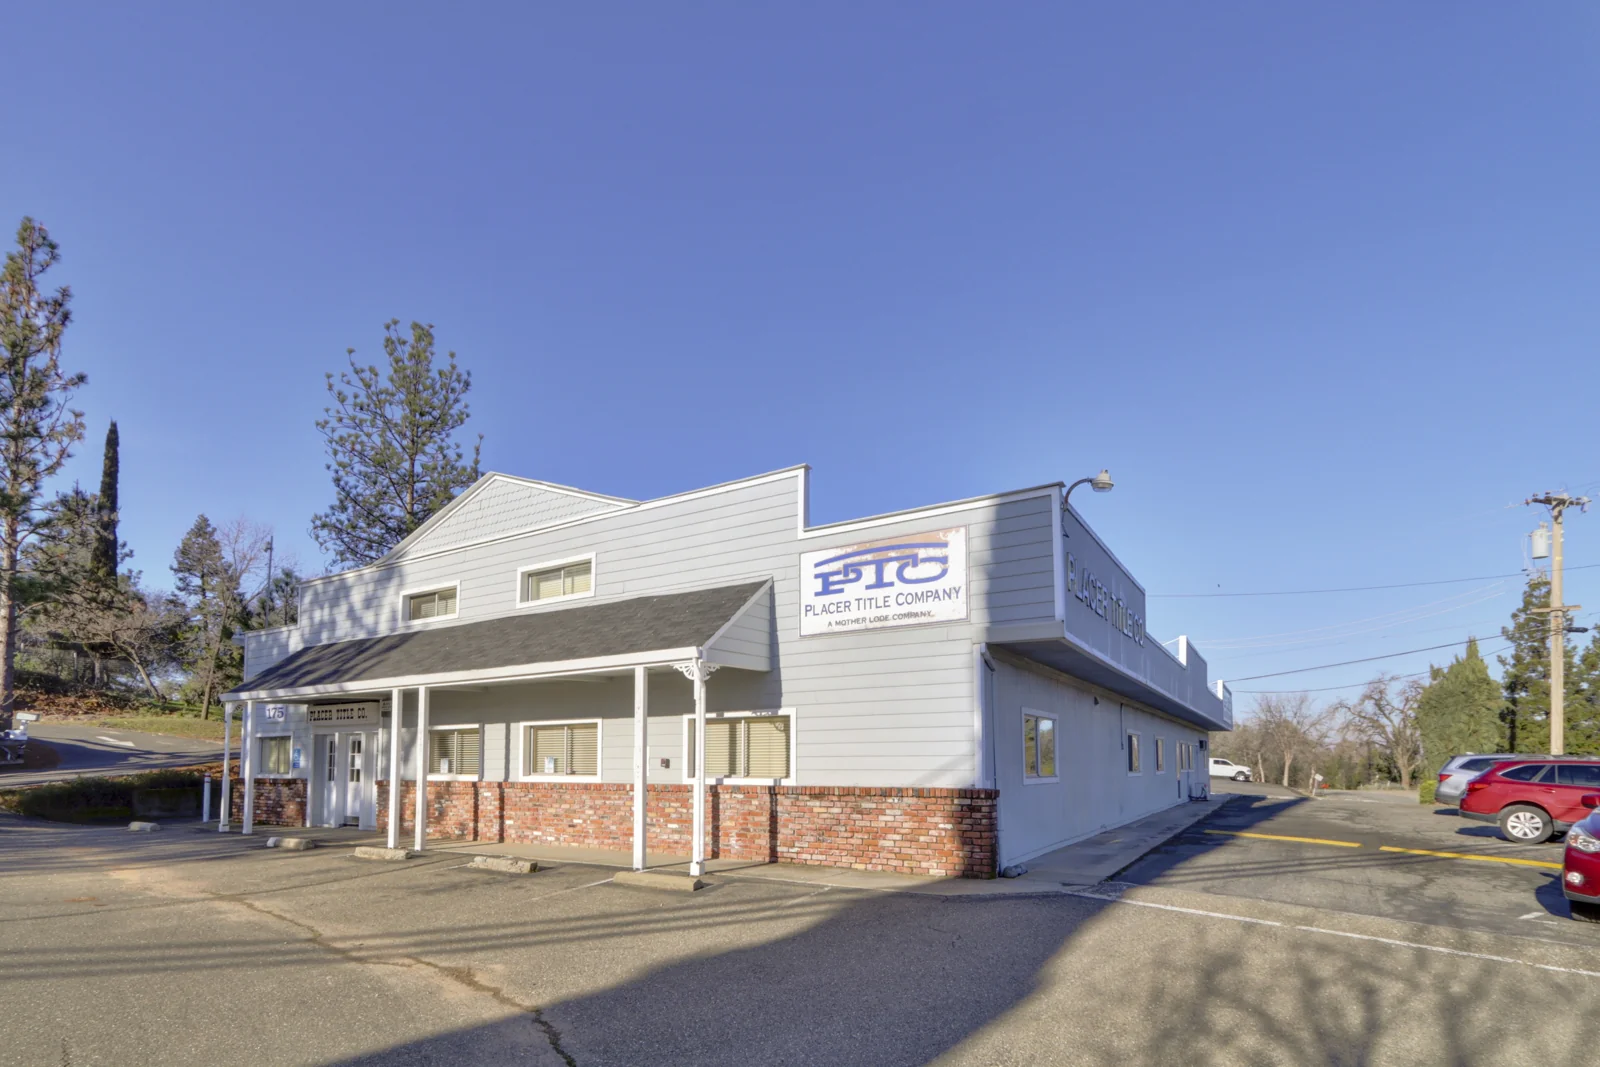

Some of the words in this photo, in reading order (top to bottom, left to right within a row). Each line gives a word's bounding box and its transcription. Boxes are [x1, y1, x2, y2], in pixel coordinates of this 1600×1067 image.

[814, 553, 948, 597] PTC
[805, 600, 852, 617] PLACER
[855, 596, 891, 611] TITLE
[895, 586, 962, 606] COMPANY
[1066, 552, 1108, 621] PLACER
[1110, 592, 1132, 639] TITLE
[835, 617, 867, 627] MOTHER
[869, 615, 890, 623] LODE
[267, 707, 284, 719] 175
[310, 710, 332, 721] PLACER
[337, 708, 354, 720] TITLE
[358, 707, 367, 719] CO.
